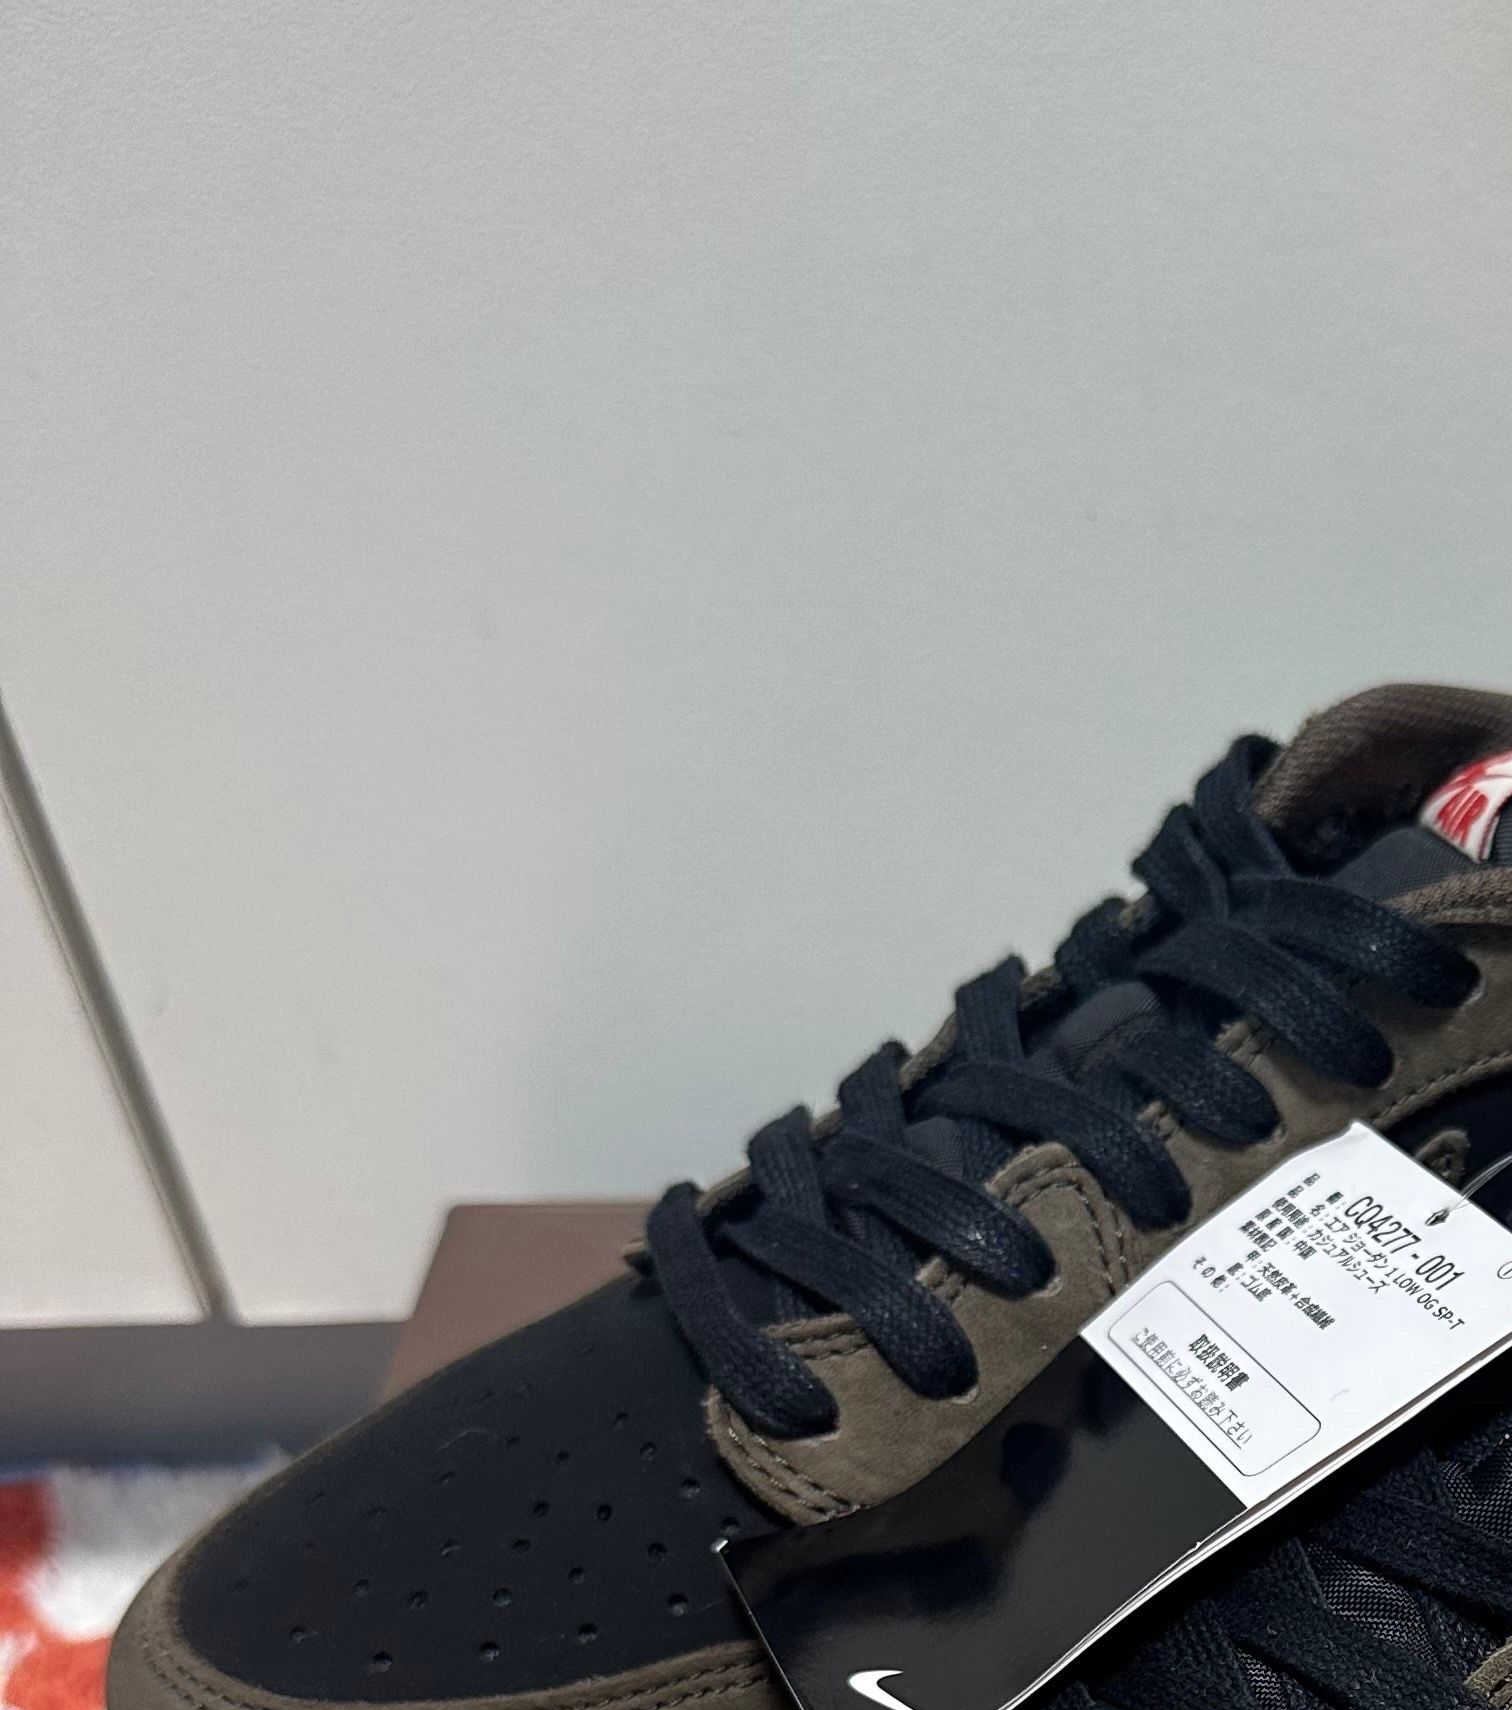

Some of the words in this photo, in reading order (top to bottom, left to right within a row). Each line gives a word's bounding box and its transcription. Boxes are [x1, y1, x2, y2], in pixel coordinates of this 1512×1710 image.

[1391, 1272, 1424, 1296] LOW
[1415, 1292, 1439, 1310] OG
[1431, 1305, 1465, 1330] SP-T
